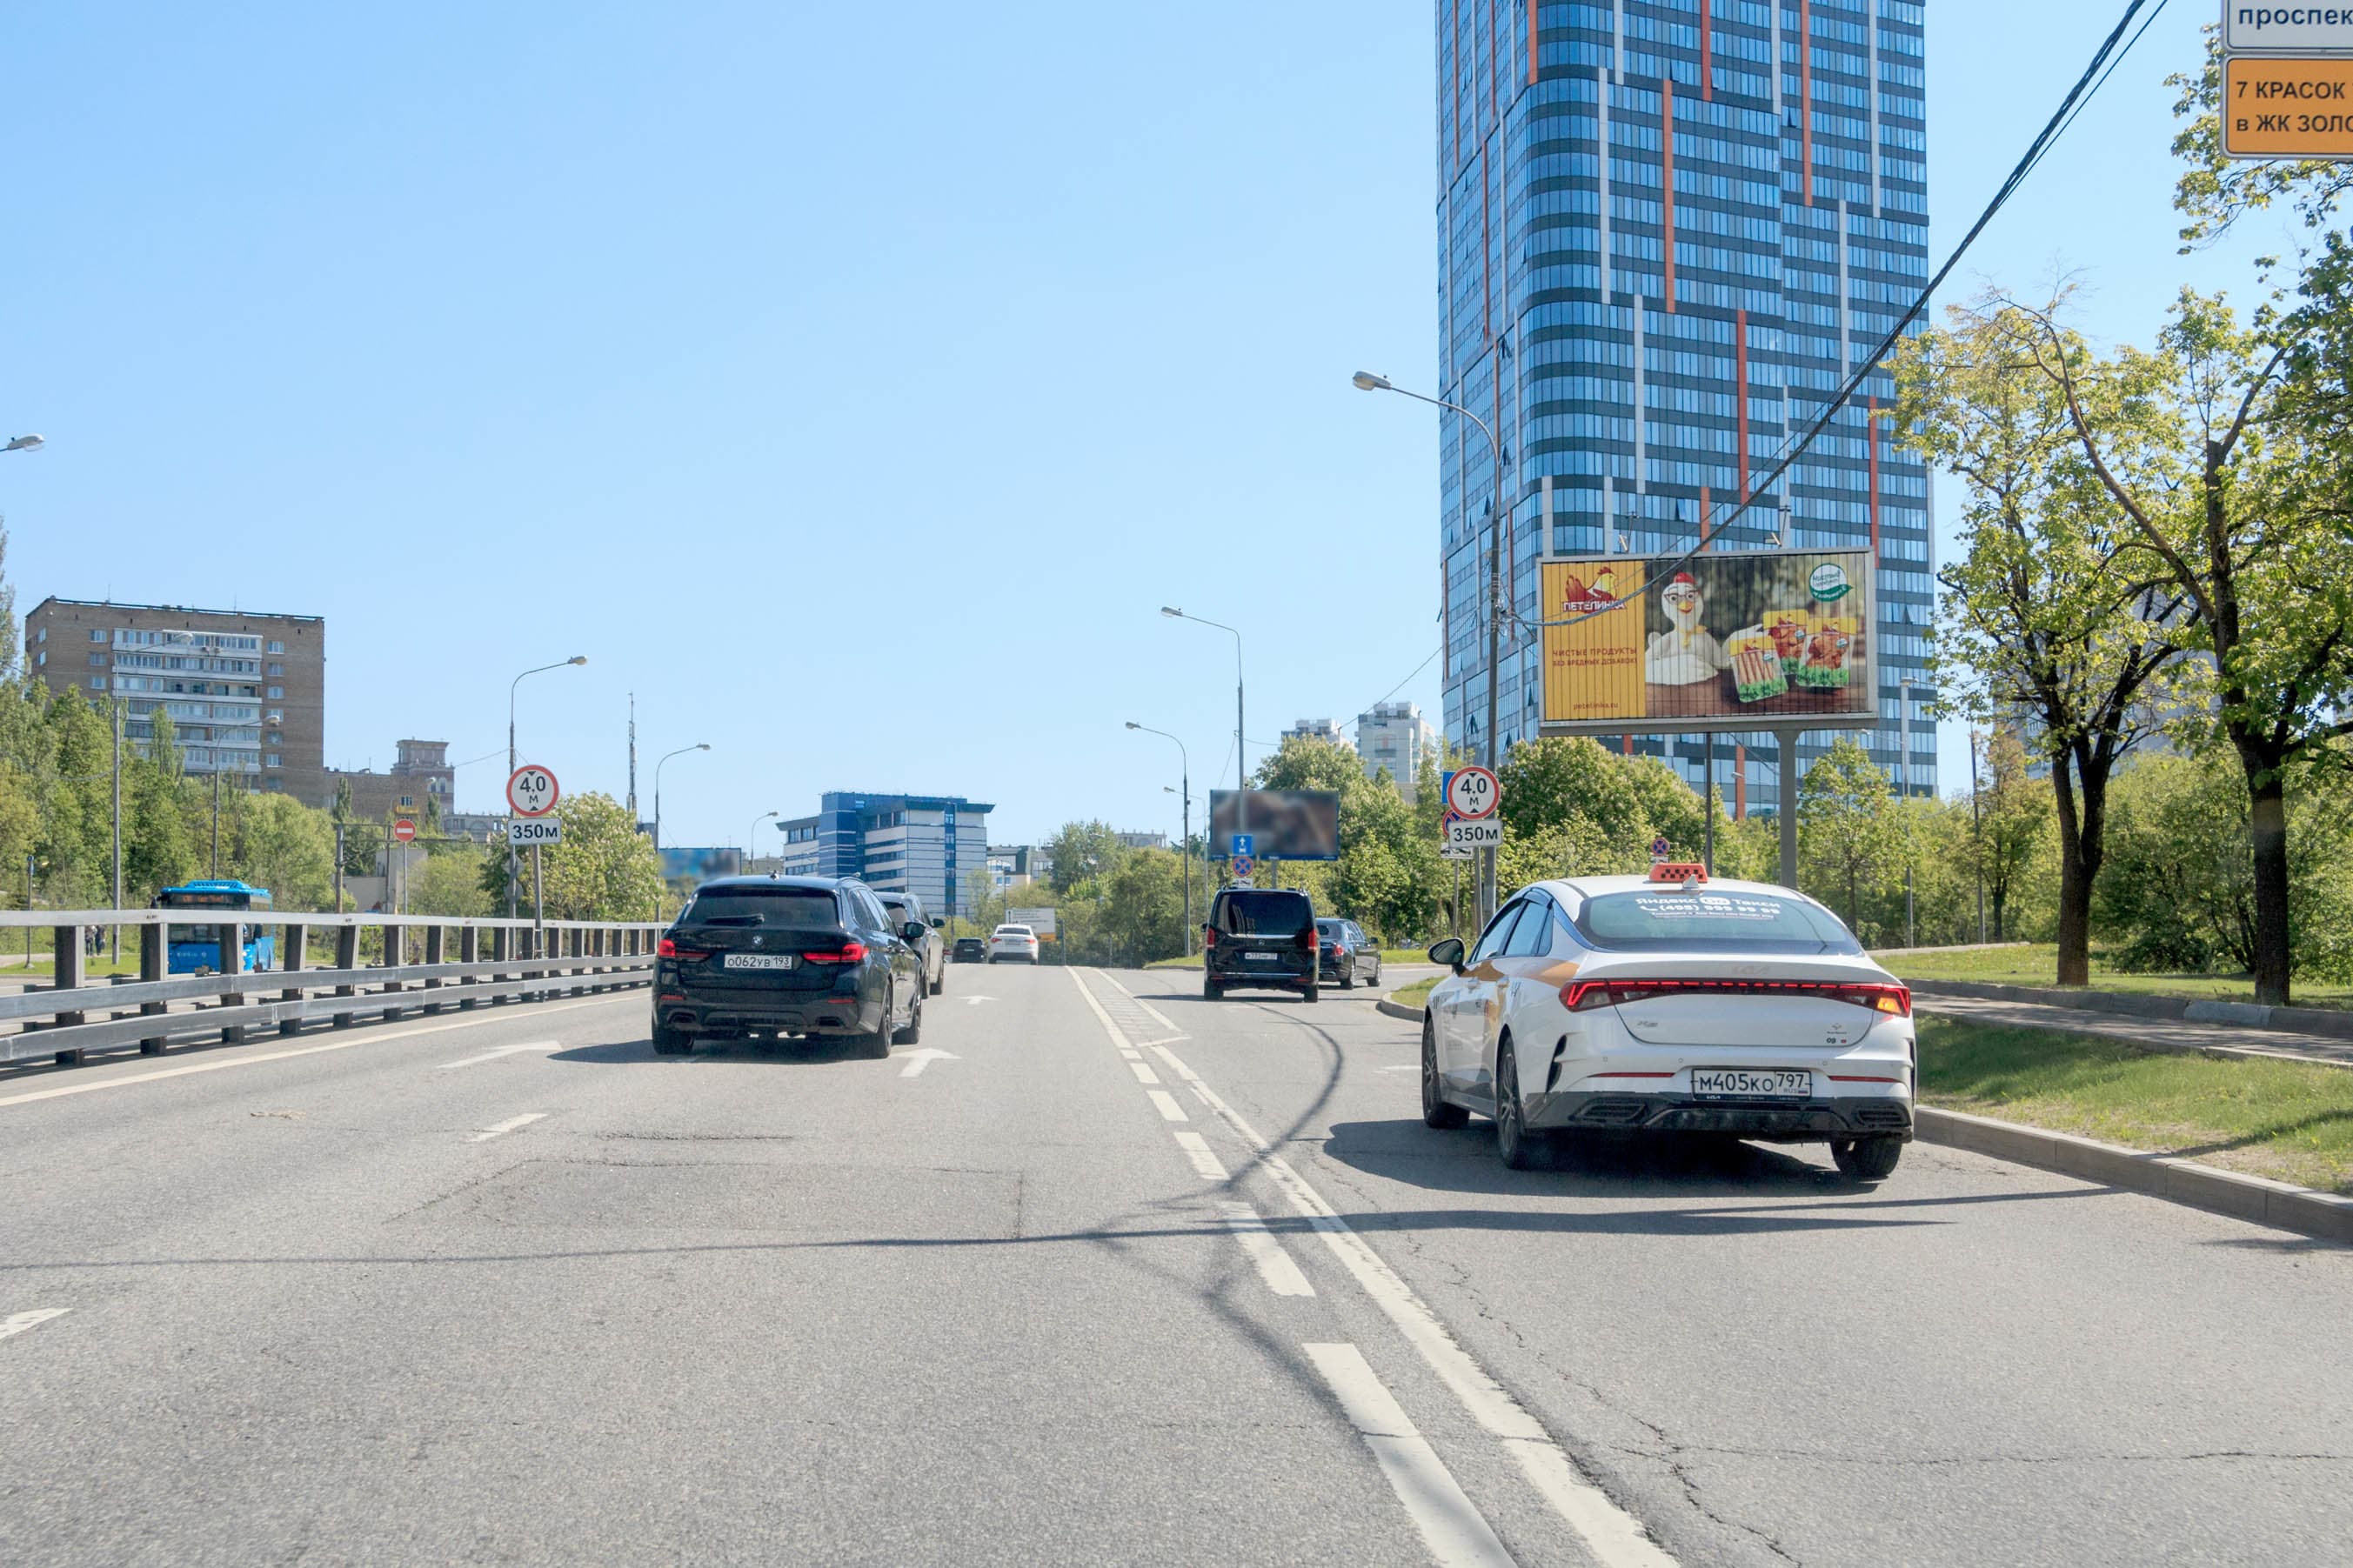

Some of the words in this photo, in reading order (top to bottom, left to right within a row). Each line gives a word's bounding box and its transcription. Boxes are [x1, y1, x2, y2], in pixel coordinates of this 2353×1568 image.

[2236, 82, 2248, 97] 7
[2256, 82, 2345, 99] КРАСОК
[2236, 119, 2249, 130] в
[2256, 115, 2290, 131] ЖК
[1461, 777, 1487, 794] 4.0
[1732, 899, 1781, 908] Такси
[773, 957, 789, 965] 193
[1776, 1074, 1804, 1087] 797
